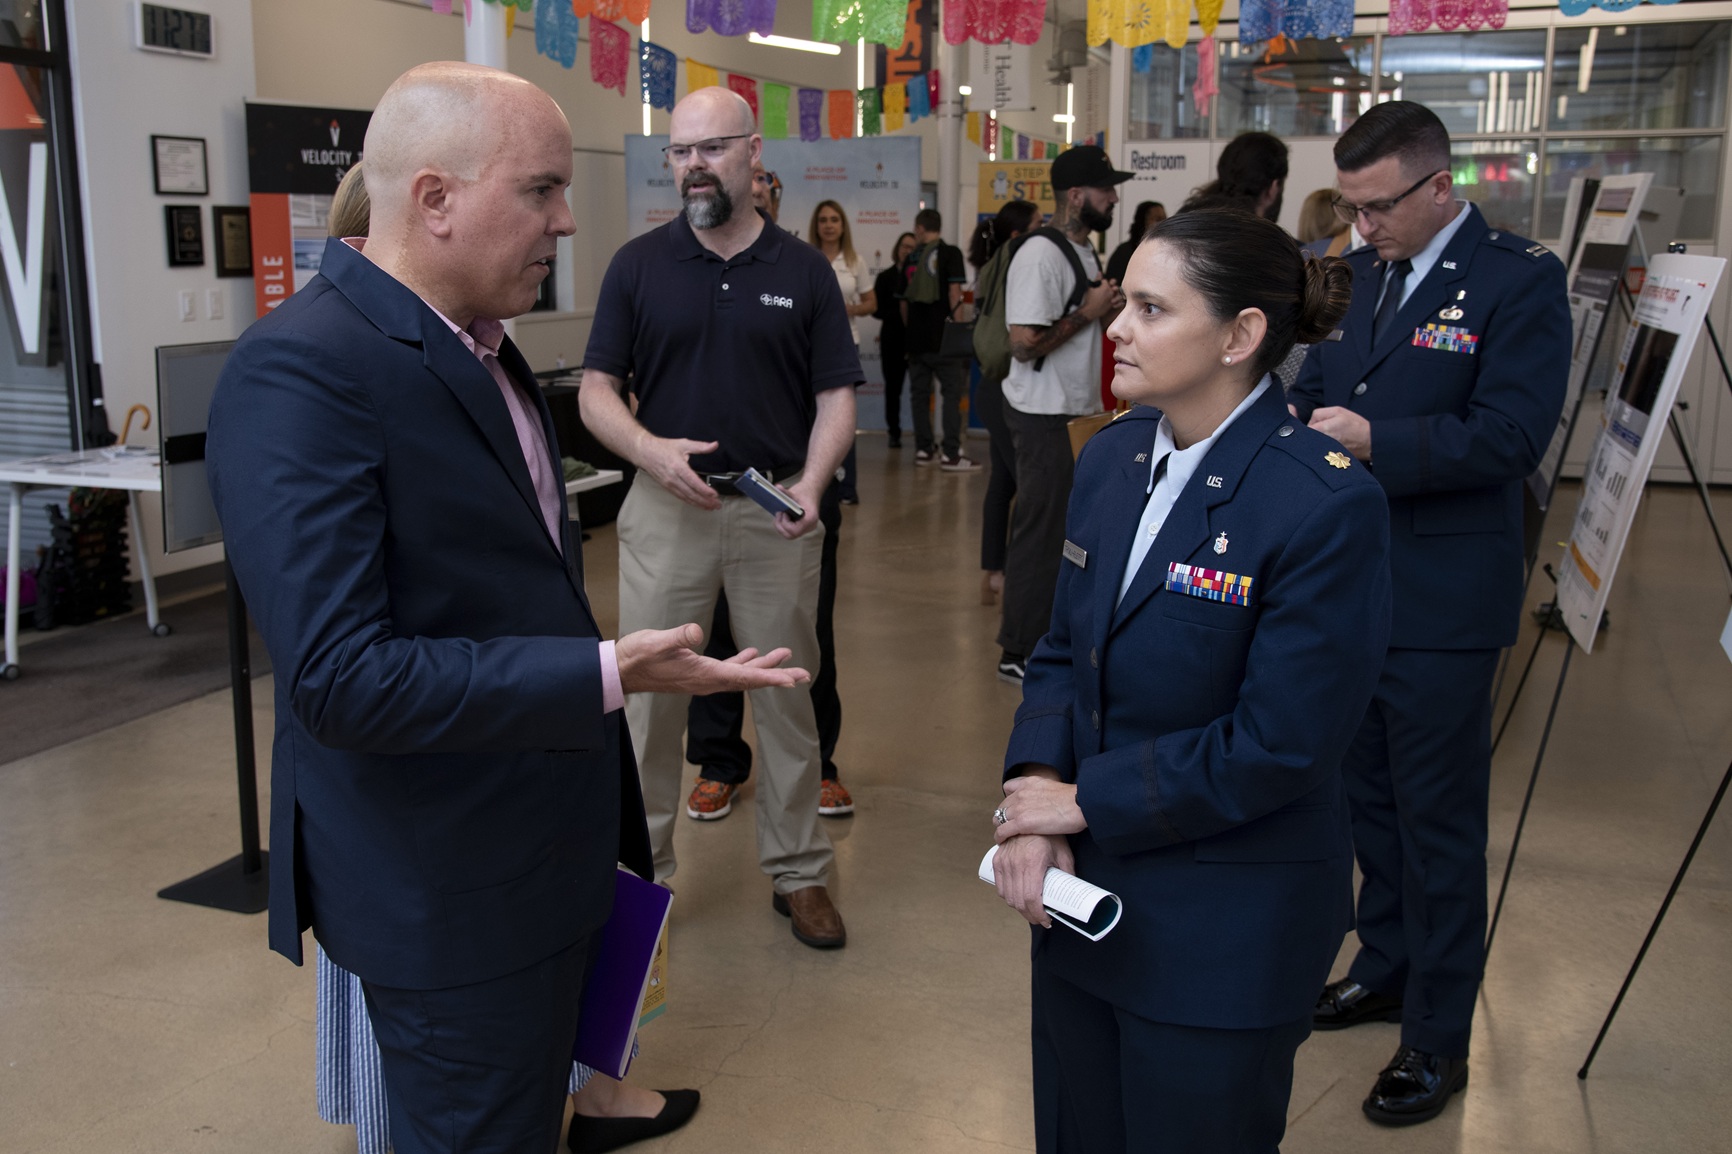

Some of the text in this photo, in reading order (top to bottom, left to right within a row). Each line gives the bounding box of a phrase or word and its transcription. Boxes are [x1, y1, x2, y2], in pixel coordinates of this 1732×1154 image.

[995, 54, 1012, 109] Health
[301, 149, 352, 166] VELOCITY
[1131, 150, 1186, 171] Restroom
[1014, 167, 1044, 179] STEP
[1013, 181, 1055, 201] STE
[773, 295, 793, 309] ARA
